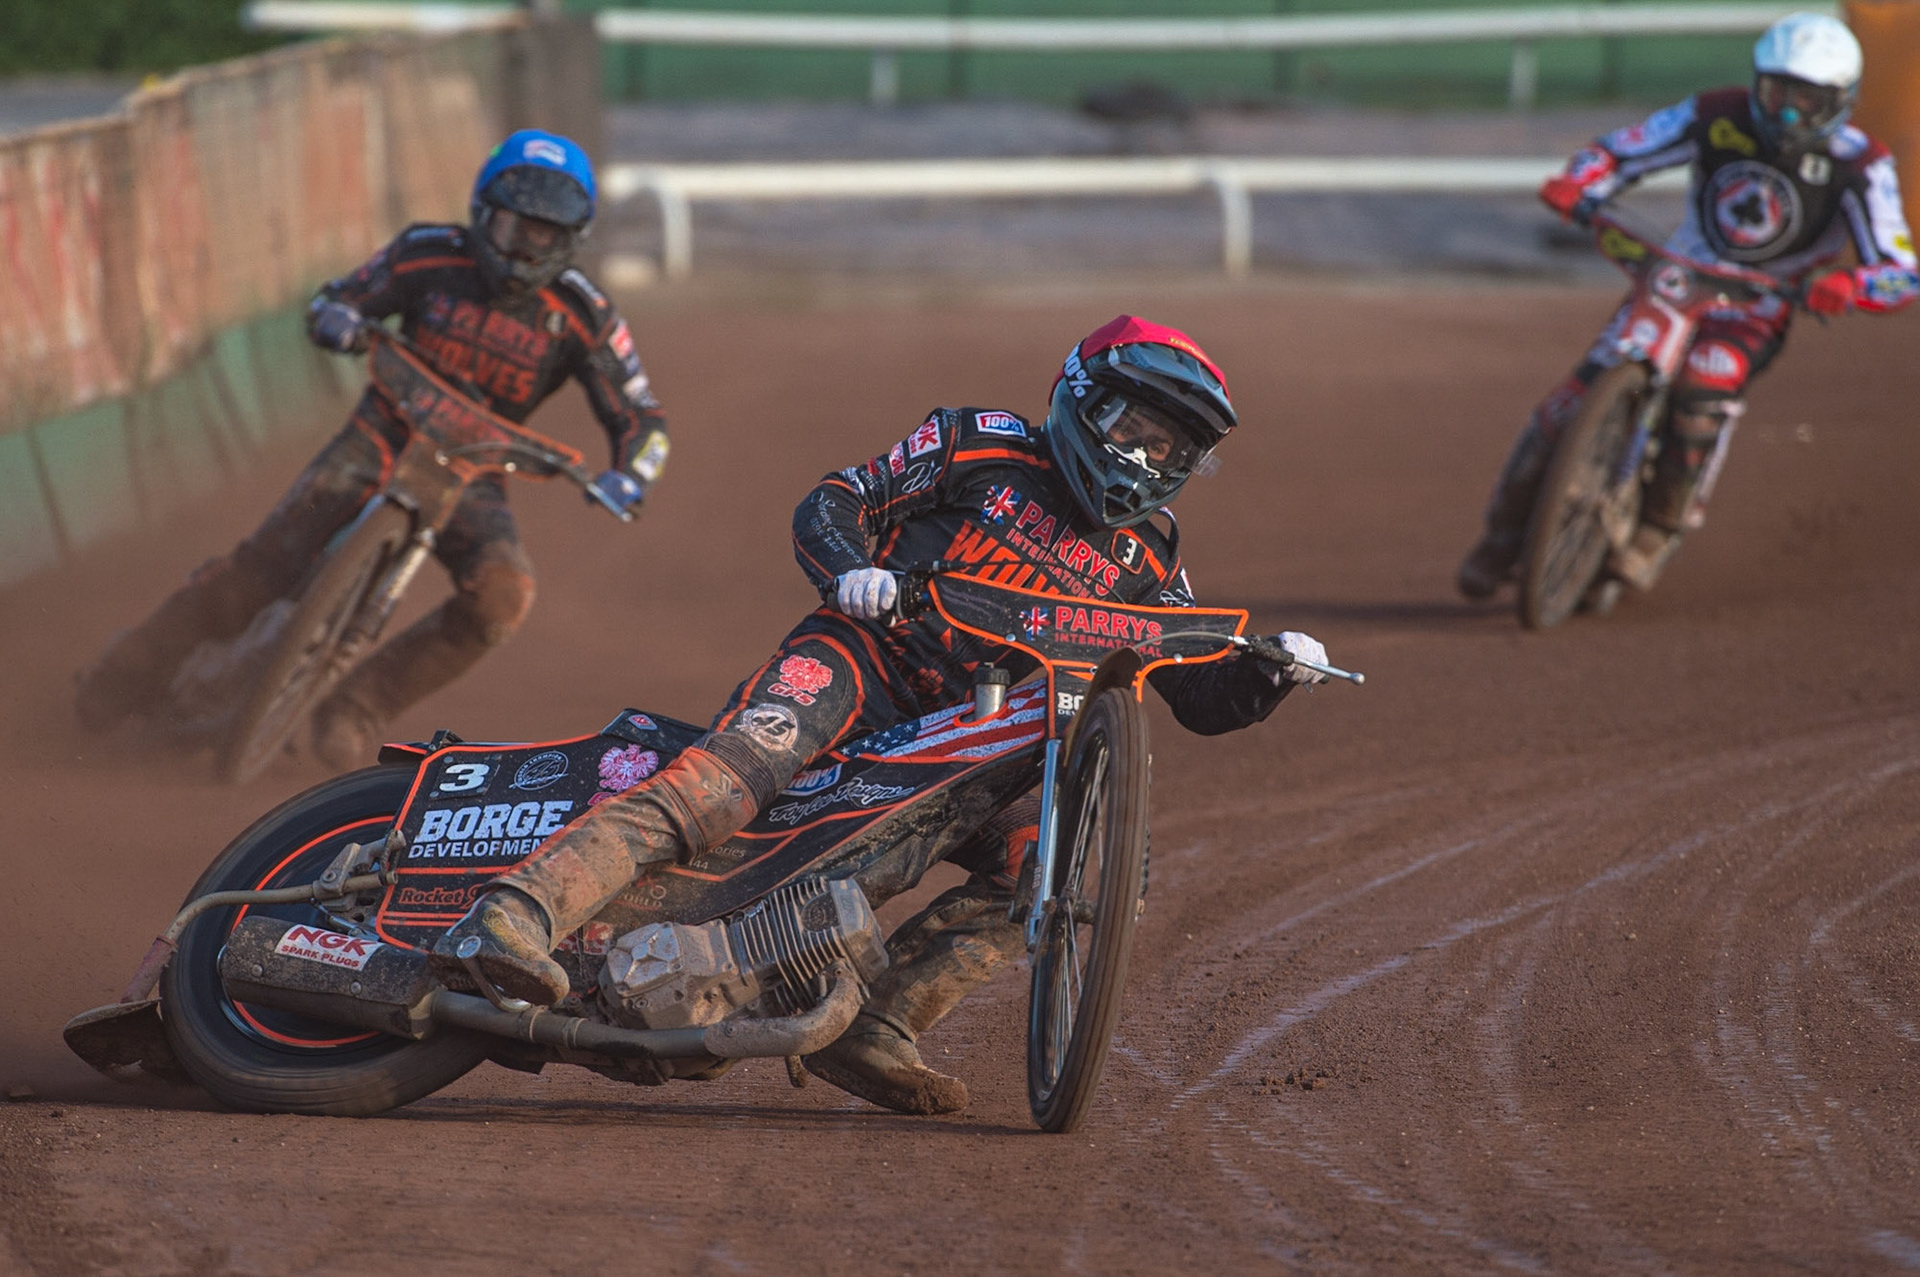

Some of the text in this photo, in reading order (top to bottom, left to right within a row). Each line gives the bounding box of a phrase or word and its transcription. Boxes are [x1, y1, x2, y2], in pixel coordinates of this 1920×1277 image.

[917, 416, 938, 450] GK
[983, 415, 1020, 432] 100%
[1016, 500, 1120, 597] PARRYS
[1122, 537, 1137, 566] 3
[1055, 605, 1163, 646] PARRYS
[767, 682, 816, 706] GPS
[439, 763, 490, 792] 3
[413, 800, 574, 843] BORGE
[399, 887, 465, 906] Rocket
[288, 926, 377, 957] NGK
[281, 945, 360, 968] SPARK PLUGS
